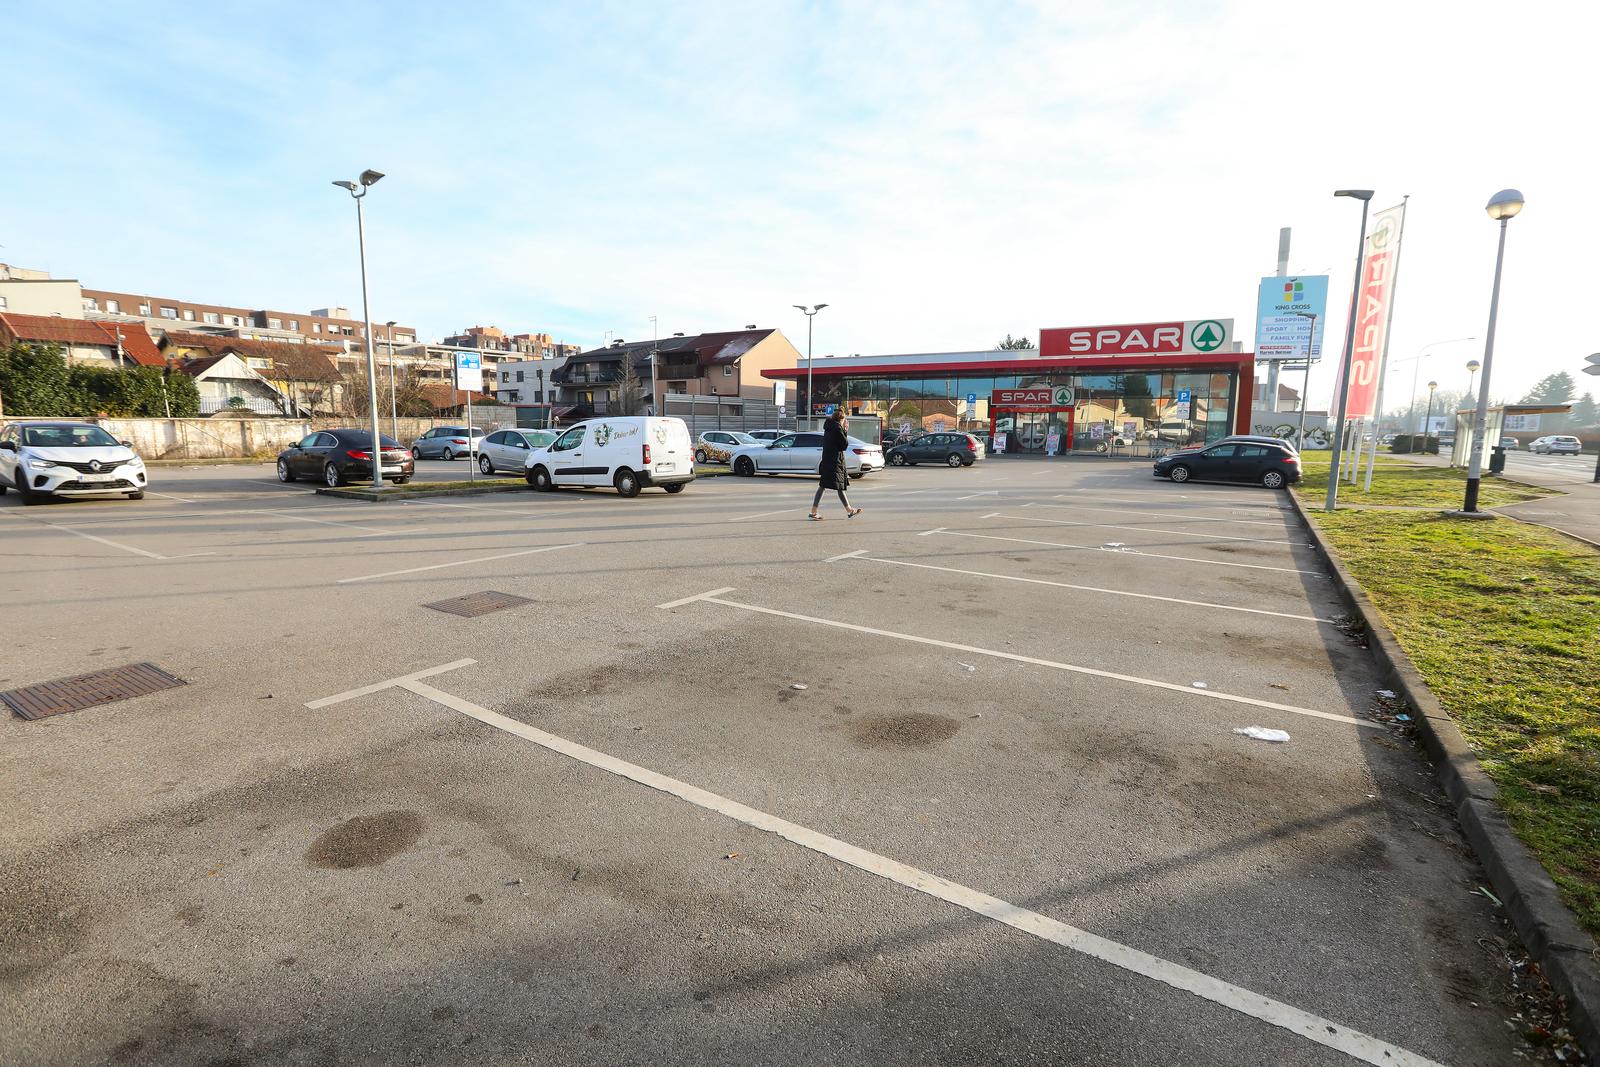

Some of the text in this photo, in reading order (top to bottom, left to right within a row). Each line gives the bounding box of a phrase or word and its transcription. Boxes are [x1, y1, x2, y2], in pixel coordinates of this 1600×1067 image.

[1069, 327, 1181, 352] SPAR
[459, 353, 466, 365] P
[1001, 392, 1049, 402] SPAR
[1181, 392, 1187, 400] P
